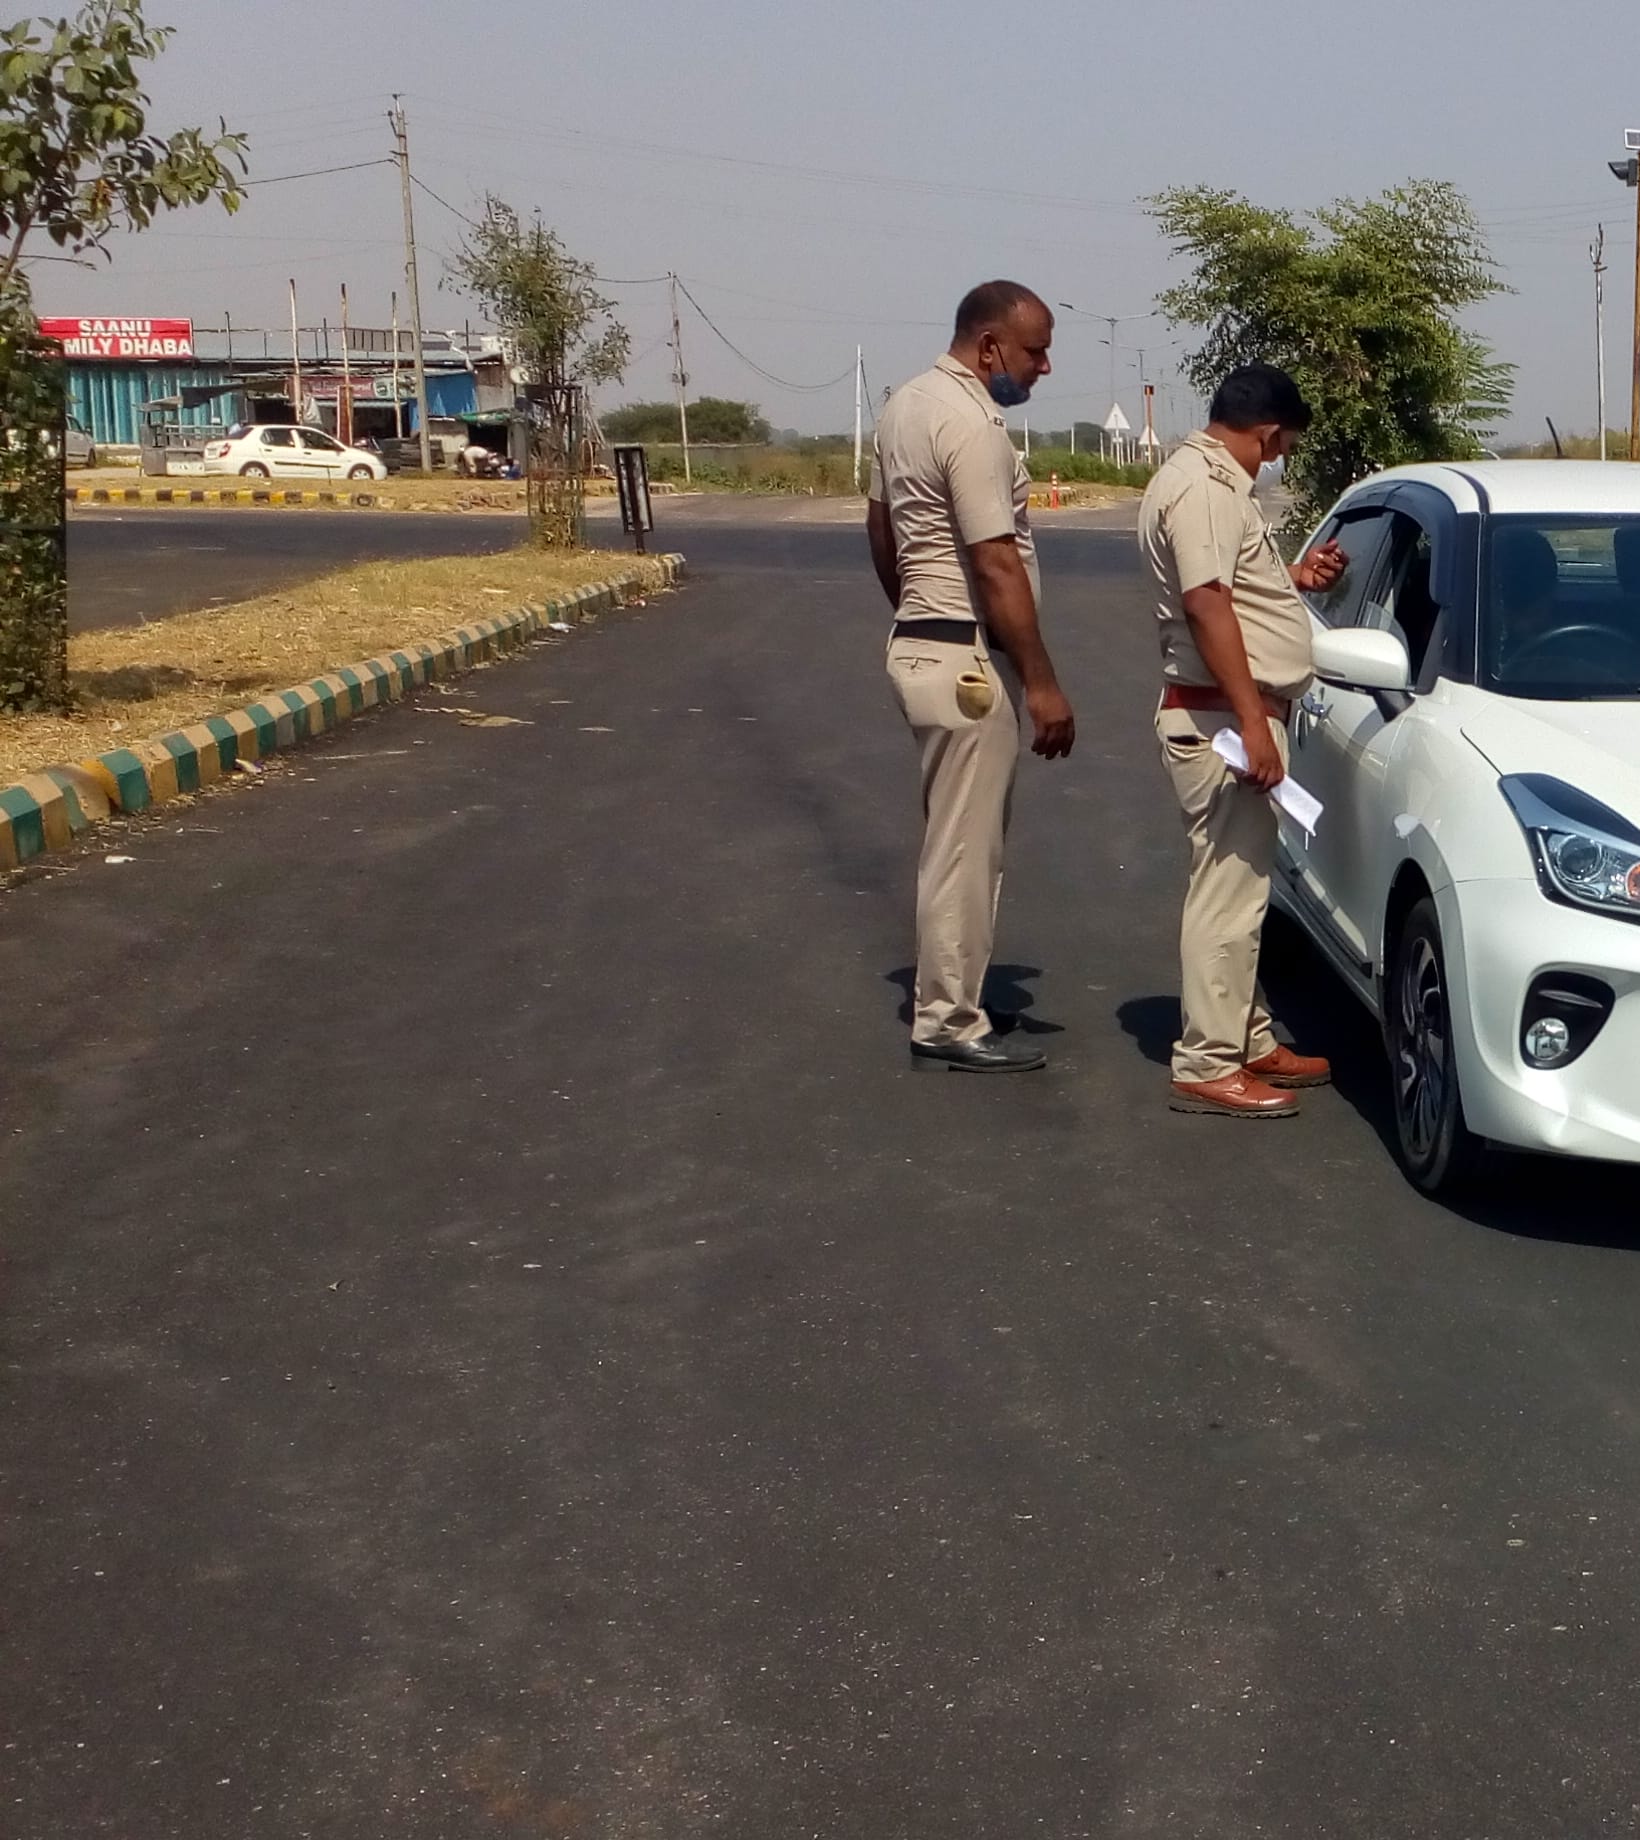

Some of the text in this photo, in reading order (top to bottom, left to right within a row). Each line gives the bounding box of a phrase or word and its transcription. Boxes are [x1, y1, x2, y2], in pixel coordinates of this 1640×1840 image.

[78, 320, 152, 337] SAANU
[64, 338, 192, 356] MILY DHABA
